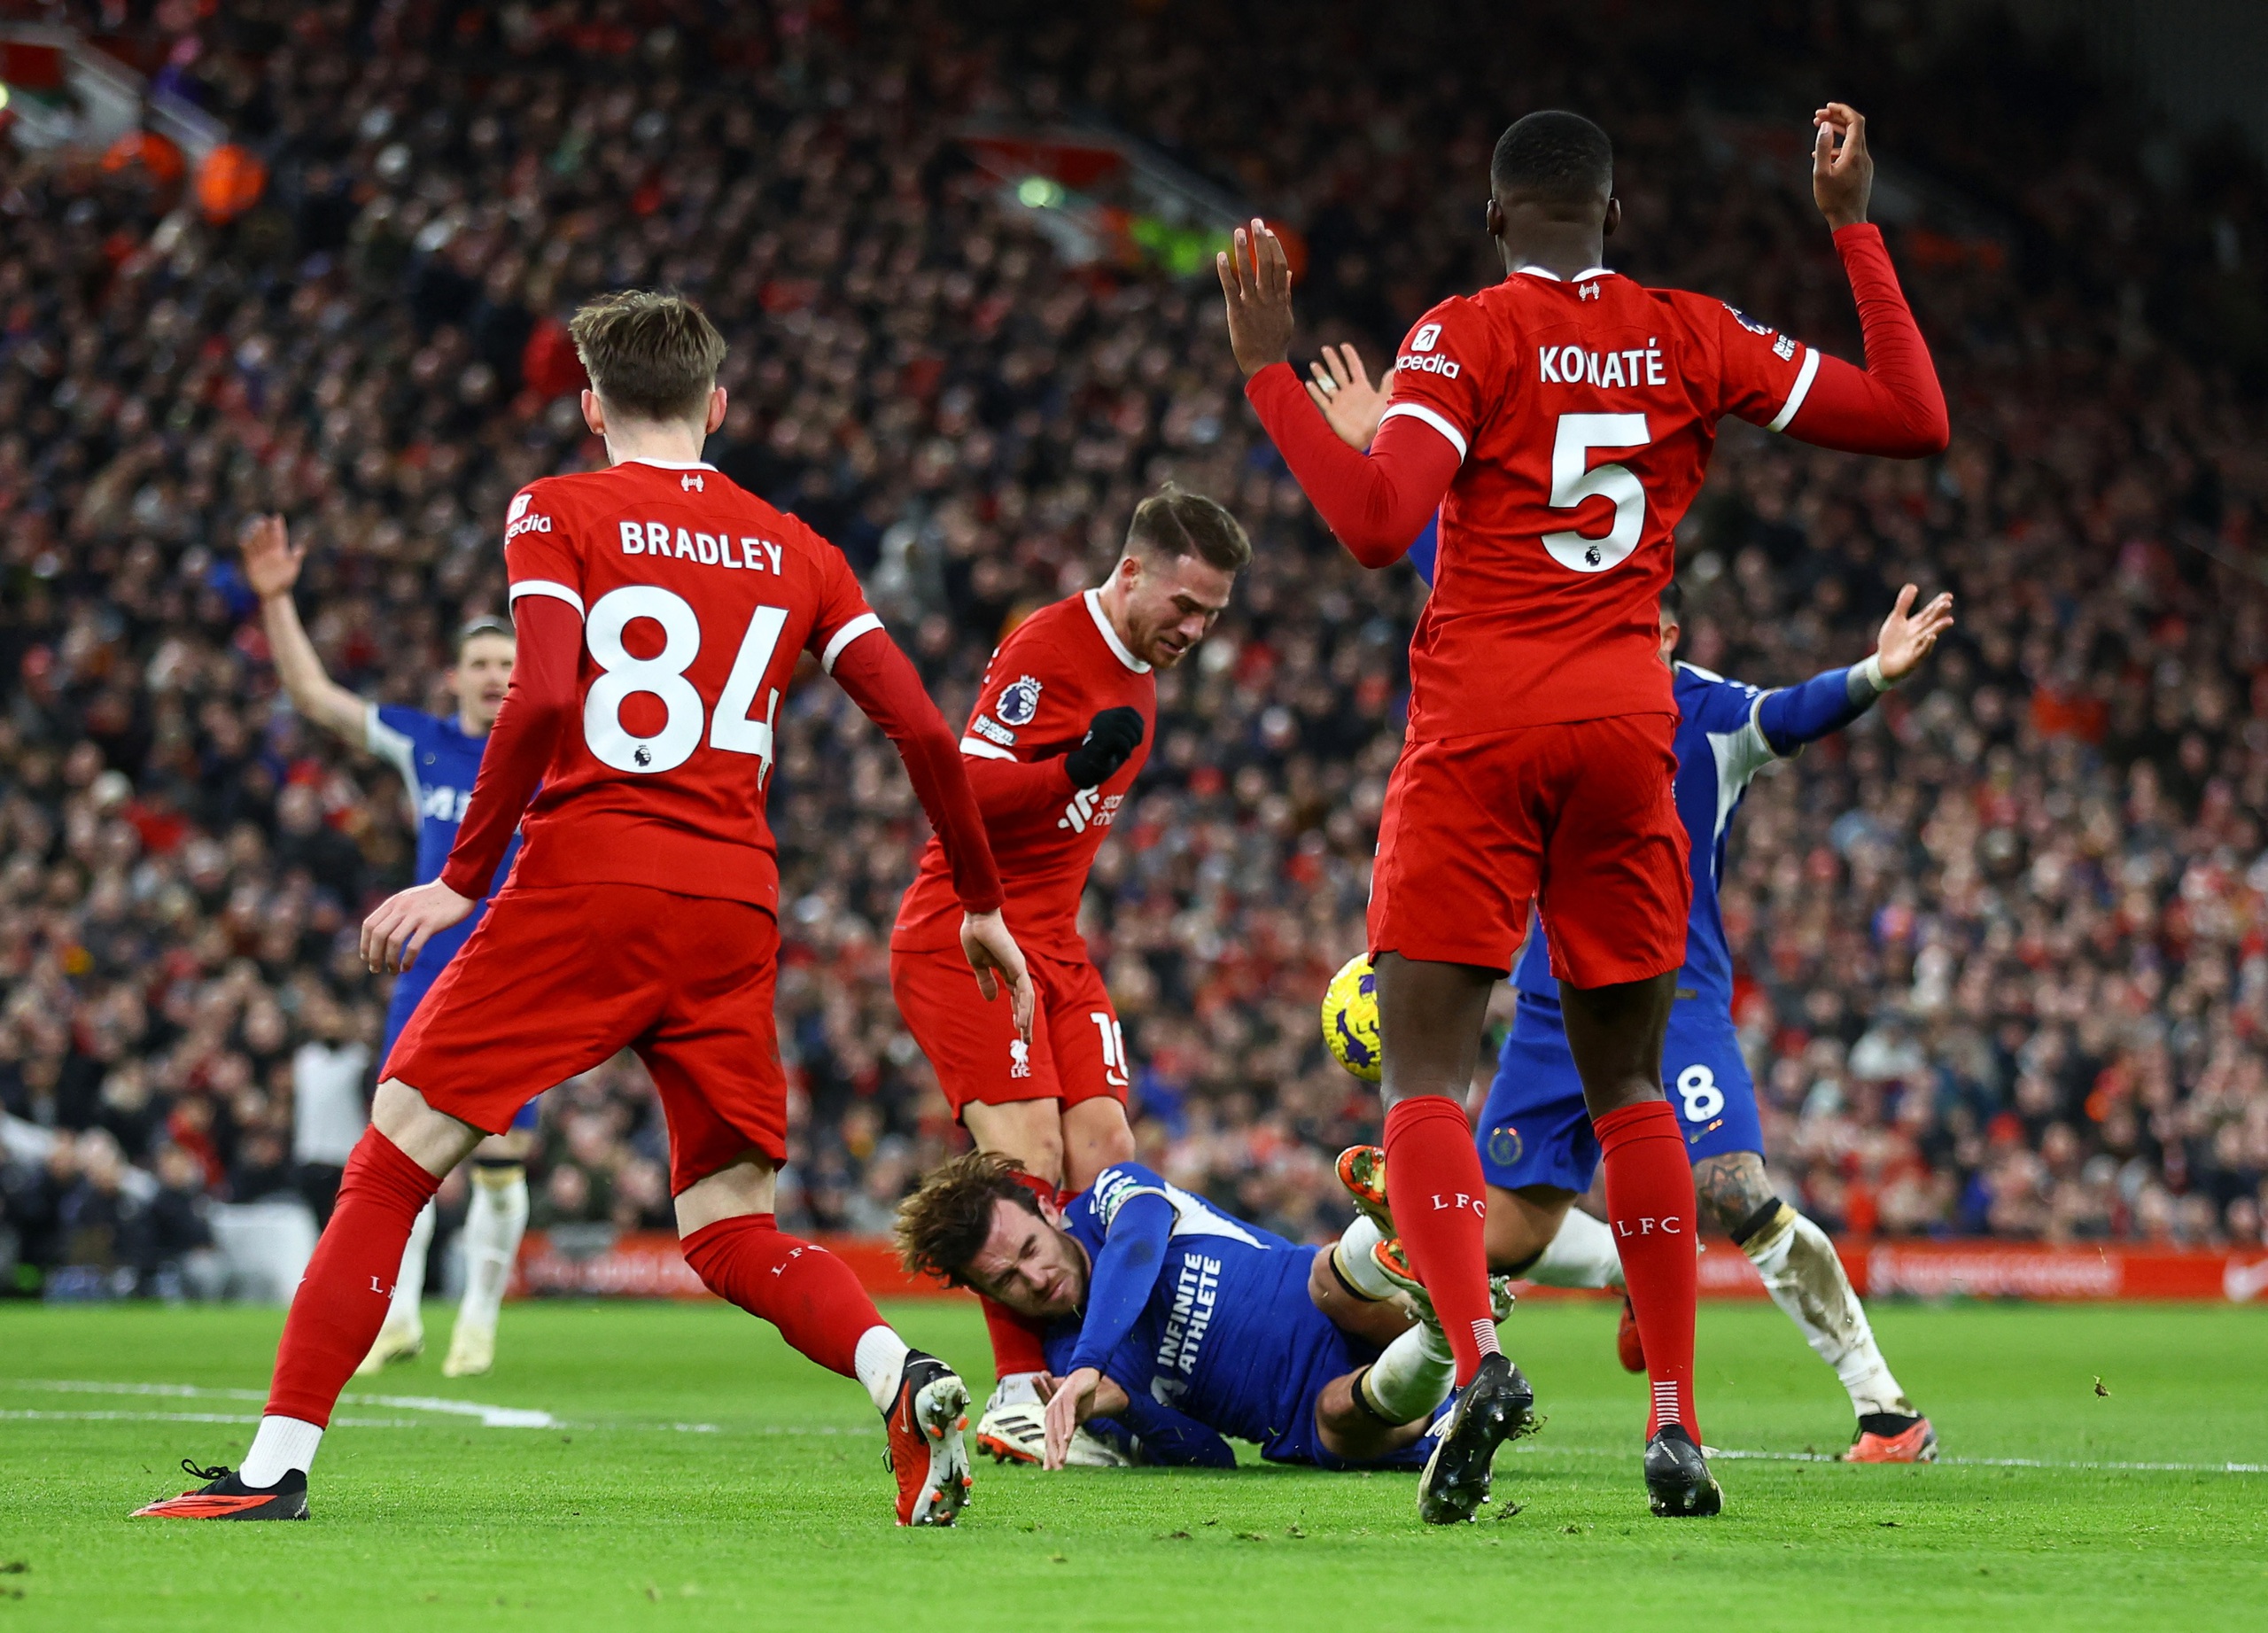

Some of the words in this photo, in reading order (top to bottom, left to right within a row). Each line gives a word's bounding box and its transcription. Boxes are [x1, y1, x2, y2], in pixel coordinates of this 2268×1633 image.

[1539, 338, 1666, 388] KONATÉ
[1542, 413, 1651, 572] 5
[619, 521, 781, 576] BRADLEY
[584, 584, 789, 790] 84
[1011, 1064, 1032, 1078] LFC
[1677, 1063, 1725, 1123] 8
[1432, 1193, 1486, 1218] LFC
[1617, 1216, 1681, 1238] LFC
[771, 1245, 830, 1278] LFC
[1157, 1252, 1202, 1368] INFINITE
[1177, 1256, 1221, 1375] ATHLETE
